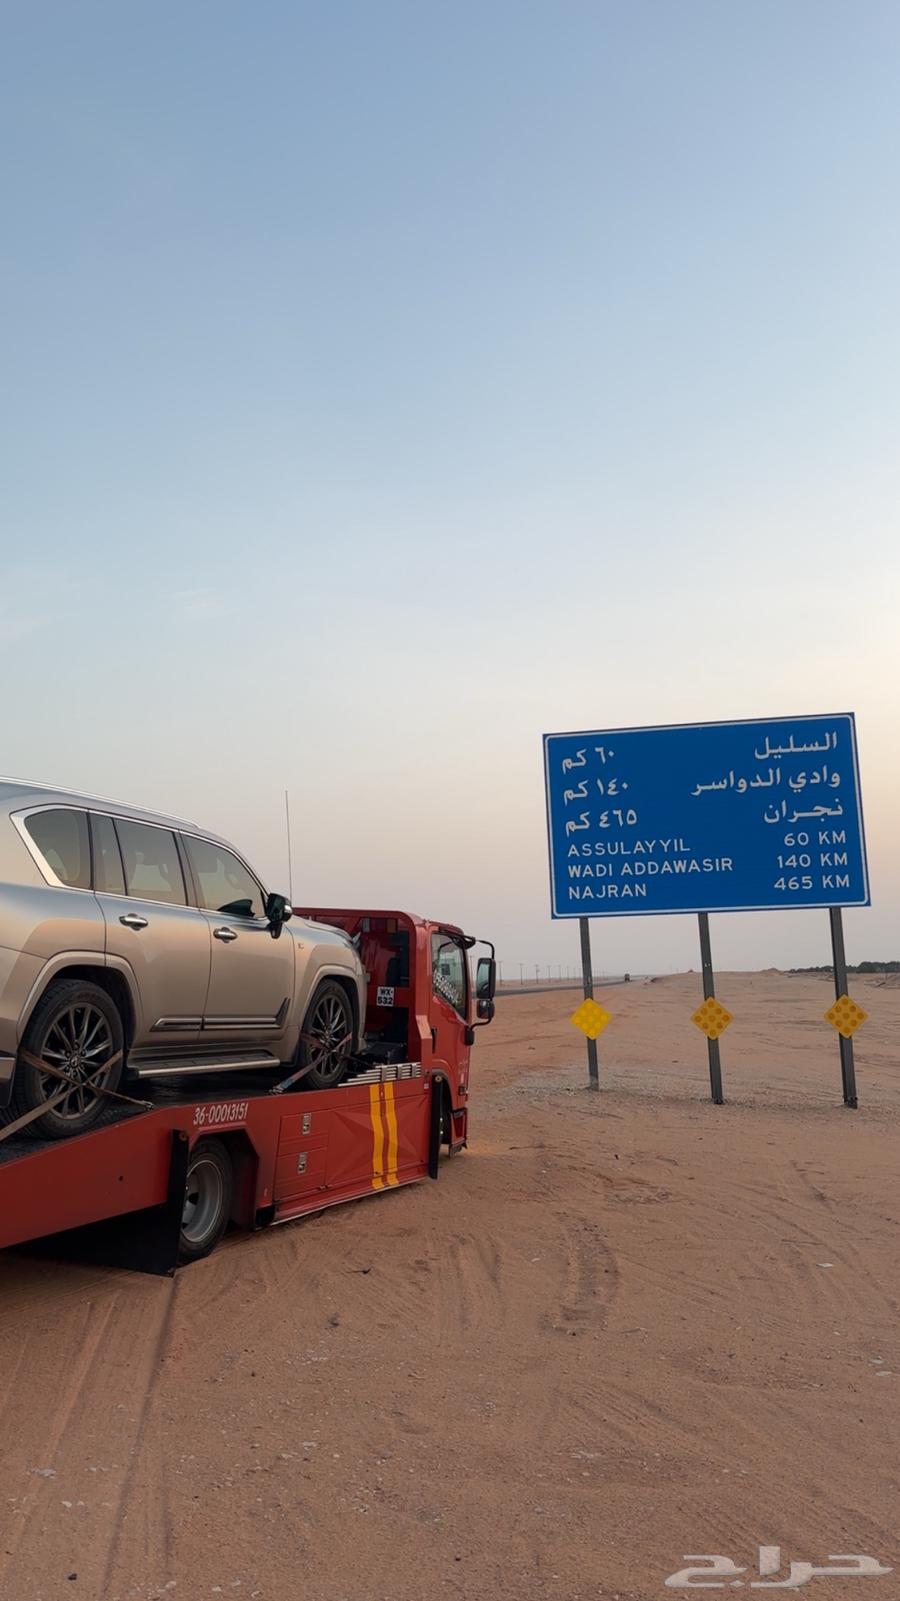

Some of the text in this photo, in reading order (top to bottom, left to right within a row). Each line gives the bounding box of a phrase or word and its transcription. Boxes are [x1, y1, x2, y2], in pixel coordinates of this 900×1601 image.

[754, 731, 838, 760] السليل
[562, 746, 615, 774] ٦٠ كم
[563, 778, 629, 805] ١٤٠ كم
[690, 765, 841, 797] وادي الدواسر
[565, 808, 638, 837] ٤٦٥ كم
[763, 797, 844, 825] نجران
[567, 838, 691, 858] ASSULAYYIL
[784, 830, 847, 847] 60 KM
[568, 857, 733, 879] WADI ADDAWASIR
[777, 852, 849, 869] 140 KM
[569, 883, 648, 900] NAJRAN
[773, 874, 850, 891] 465 KM
[192, 1102, 249, 1126] 36-00013151
